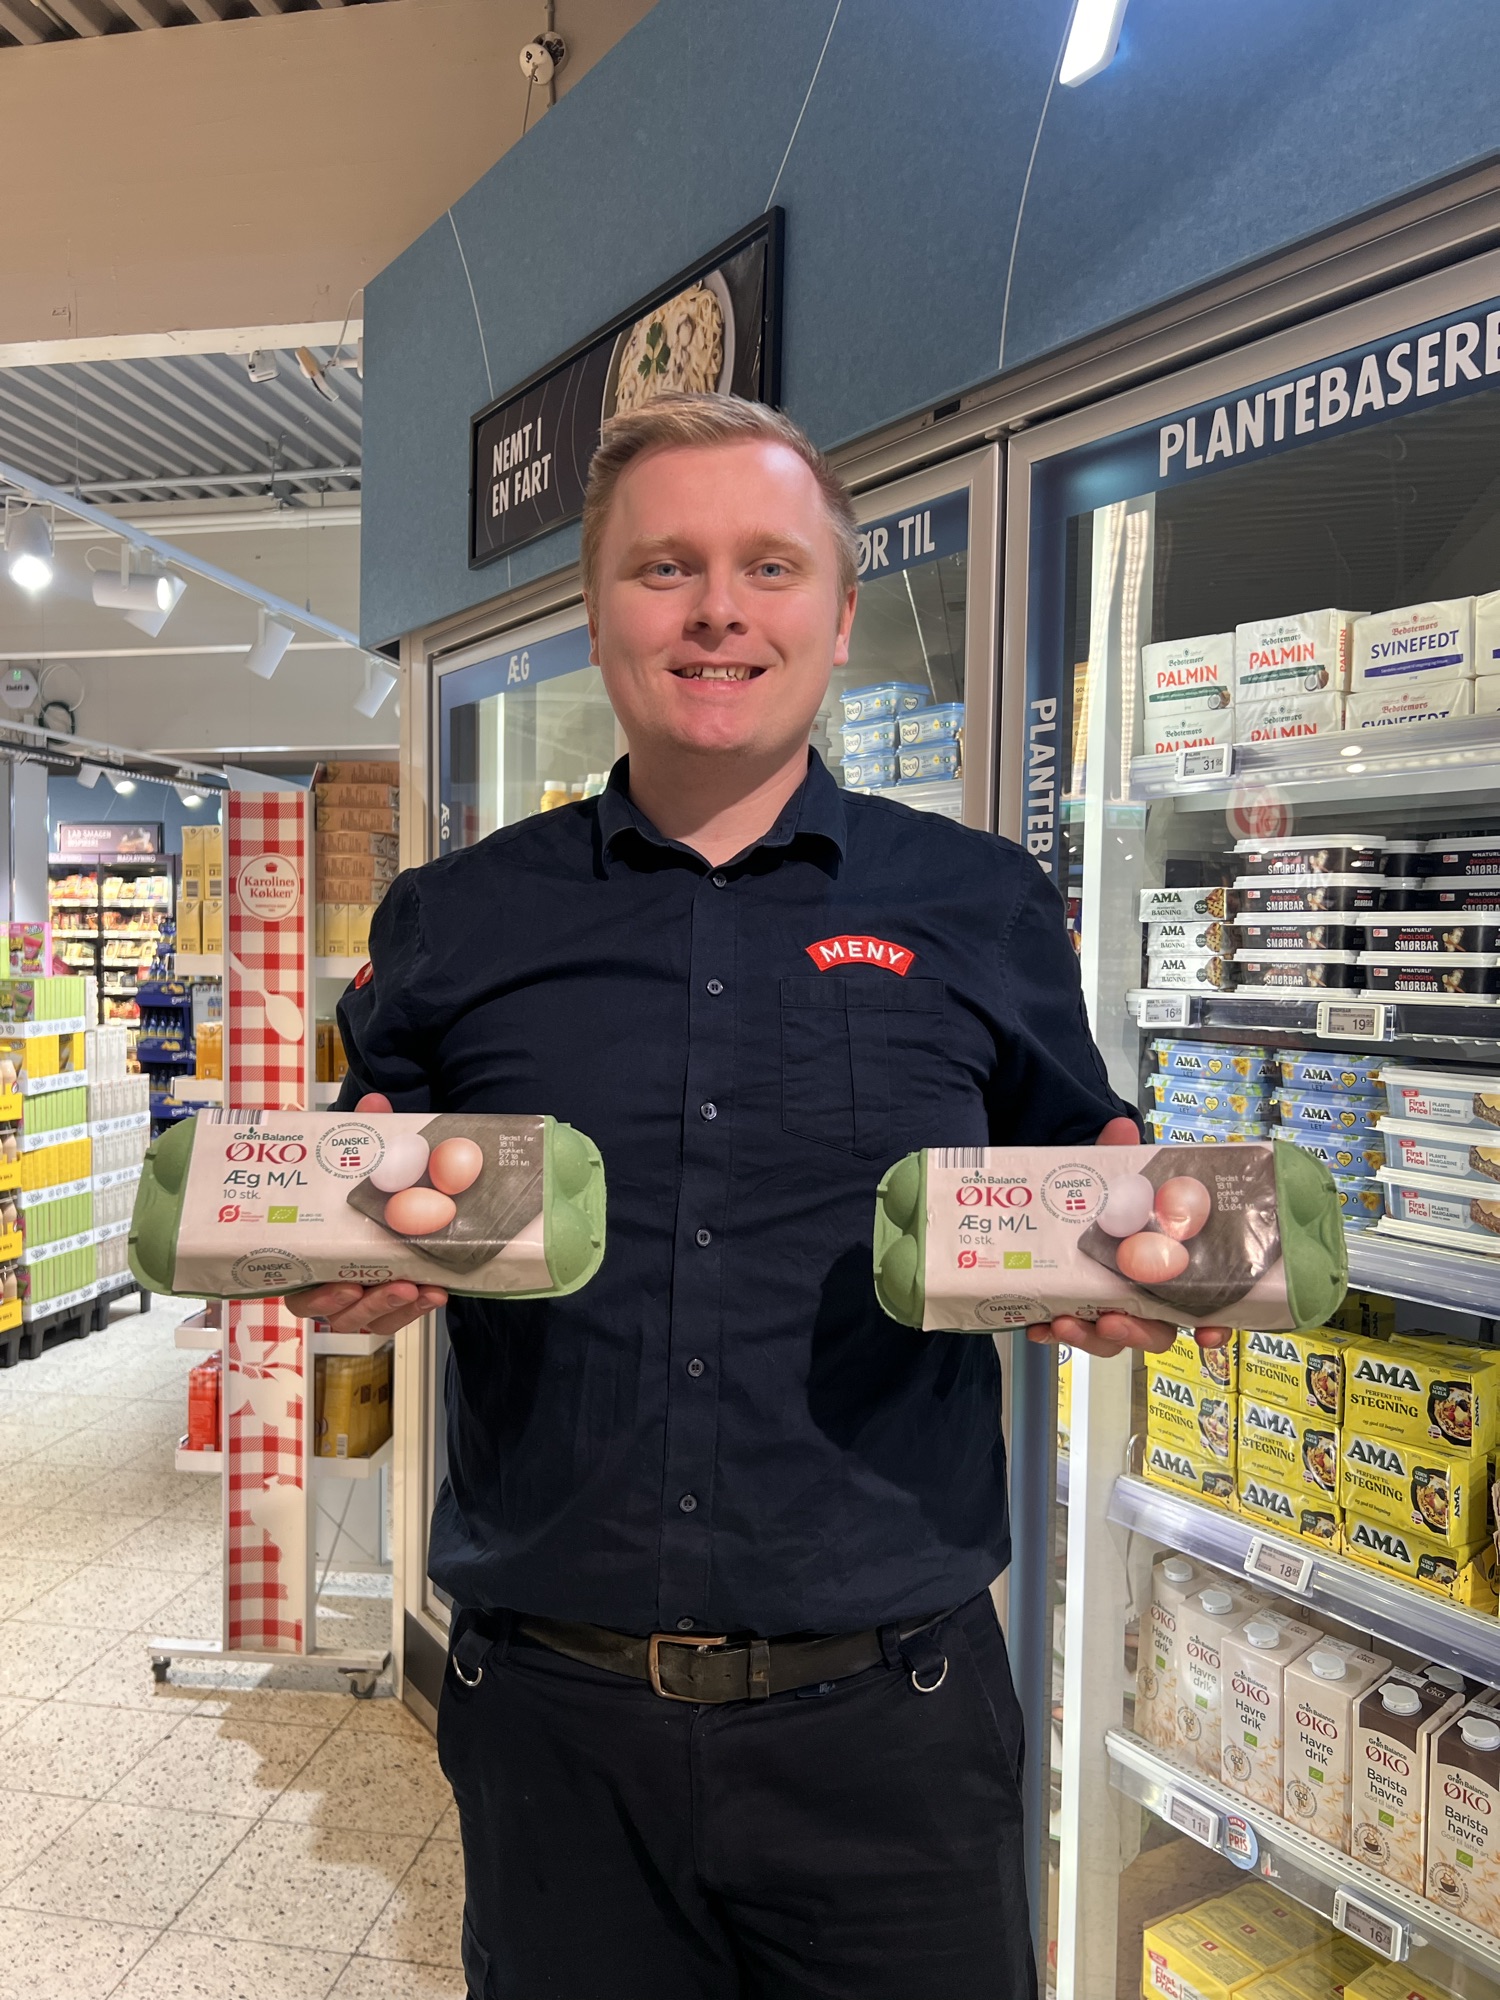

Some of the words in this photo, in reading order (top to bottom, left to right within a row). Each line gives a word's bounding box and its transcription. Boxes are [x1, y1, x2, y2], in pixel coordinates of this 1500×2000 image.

[492, 425, 534, 478] NEMT
[535, 417, 543, 452] I
[491, 480, 510, 518] EN
[514, 453, 552, 509] FART
[898, 510, 936, 560] TIL
[1339, 629, 1347, 673] PALMIN
[1370, 629, 1460, 659] SVINEFEDT
[1249, 642, 1315, 670] PALMIN
[507, 651, 530, 685] ÆG
[1157, 664, 1218, 688] PALMIN
[846, 706, 860, 717] Becel
[902, 727, 917, 737] Becel
[902, 761, 917, 771] Becel
[440, 802, 450, 840] ÆG
[244, 876, 295, 887] Karolines
[250, 888, 292, 898] Køkken
[1150, 893, 1182, 904] AMA
[1151, 908, 1182, 916] BAGNING
[1266, 901, 1304, 911] SMØRBAR
[1160, 925, 1186, 936] AMA
[1160, 941, 1185, 949] BAGNING
[1266, 938, 1304, 948] SMØRBAR
[1394, 940, 1439, 951] SMØRBAR
[818, 940, 905, 965] MENY
[1161, 959, 1186, 970] AMA
[1161, 975, 1186, 983] BAGNING
[1266, 975, 1304, 986] SMØRBAR
[1394, 980, 1438, 992] SMØRBAR
[1175, 1056, 1202, 1068] AMA
[1302, 1068, 1333, 1081] AMA
[1172, 1092, 1198, 1105] AMA
[1409, 1099, 1426, 1107] First
[1301, 1107, 1332, 1121] AMA
[1409, 1106, 1428, 1115] Price
[234, 1132, 261, 1141] Grøn
[262, 1132, 304, 1141] Balance
[331, 1137, 370, 1147] DANSKE
[1170, 1129, 1196, 1143] AMA
[225, 1142, 308, 1165] ØKO
[342, 1147, 359, 1155] ÆG
[1406, 1149, 1422, 1158] First
[1406, 1156, 1425, 1165] Price
[223, 1170, 260, 1188] Æg
[267, 1169, 308, 1188] M/L
[961, 1176, 987, 1184] Grøn
[988, 1176, 1028, 1184] Balance
[1054, 1178, 1092, 1189] DANSKE
[1215, 1174, 1239, 1182] Bedst
[223, 1189, 237, 1199] 10
[239, 1189, 261, 1200] stk.
[955, 1185, 1033, 1208] ØKO
[1066, 1189, 1083, 1198] ÆG
[1408, 1200, 1425, 1209] First
[1408, 1207, 1427, 1217] Price
[1431, 1211, 1460, 1219] MARGARINE
[958, 1215, 992, 1233] Æg
[998, 1214, 1037, 1233] M/L
[958, 1235, 972, 1244] 10
[974, 1234, 995, 1245] stk.
[247, 1262, 292, 1272] DANSKE
[338, 1269, 393, 1279] ØKO
[989, 1304, 1032, 1312] DANSKE
[1248, 1333, 1301, 1363] AMA
[1245, 1362, 1299, 1388] STEGNING
[1354, 1359, 1421, 1392] AMA
[1151, 1376, 1195, 1408] AMA
[1365, 1388, 1392, 1400] PERFEKT
[1393, 1393, 1404, 1402] TIL
[1432, 1384, 1447, 1392] UDEN
[1350, 1393, 1419, 1419] STEGNING
[1149, 1404, 1194, 1430] STEGNING
[1245, 1406, 1297, 1439] AMA
[1242, 1436, 1296, 1463] STEGNING
[1347, 1439, 1405, 1476] AMA
[1151, 1448, 1197, 1480] AMA
[1356, 1468, 1381, 1481] PERFEKT
[1344, 1471, 1404, 1502] STEGNING
[1243, 1483, 1295, 1519] AMA
[1352, 1524, 1411, 1563] AMA
[1150, 1606, 1176, 1632] ØKO
[1152, 1625, 1173, 1646] Havre
[1154, 1640, 1169, 1655] drik
[1186, 1642, 1221, 1669] ØKO
[1189, 1662, 1217, 1684] Havre
[1193, 1676, 1213, 1693] drik
[1248, 1675, 1268, 1690] Balance
[1231, 1678, 1270, 1706] ØKO
[1426, 1688, 1446, 1699] ØKO
[1235, 1698, 1266, 1721] Havre
[1313, 1709, 1336, 1725] Balance
[1240, 1713, 1262, 1731] drik
[1295, 1710, 1338, 1740] ØKO
[1300, 1731, 1334, 1756] Havre
[1305, 1748, 1328, 1766] drik
[1383, 1744, 1408, 1761] Balance
[1365, 1745, 1410, 1777] ØKO
[1367, 1768, 1408, 1796] Barista
[1464, 1781, 1489, 1799] Balance
[1364, 1792, 1378, 1803] God
[1370, 1781, 1404, 1807] havre
[1443, 1782, 1492, 1815] ØKO
[1445, 1805, 1489, 1836] Barista
[1440, 1830, 1455, 1841] God
[1447, 1819, 1485, 1847] havre
[1228, 1833, 1248, 1852] PRIS
[1155, 1966, 1176, 1988] First
[1155, 1976, 1179, 1999] Price
